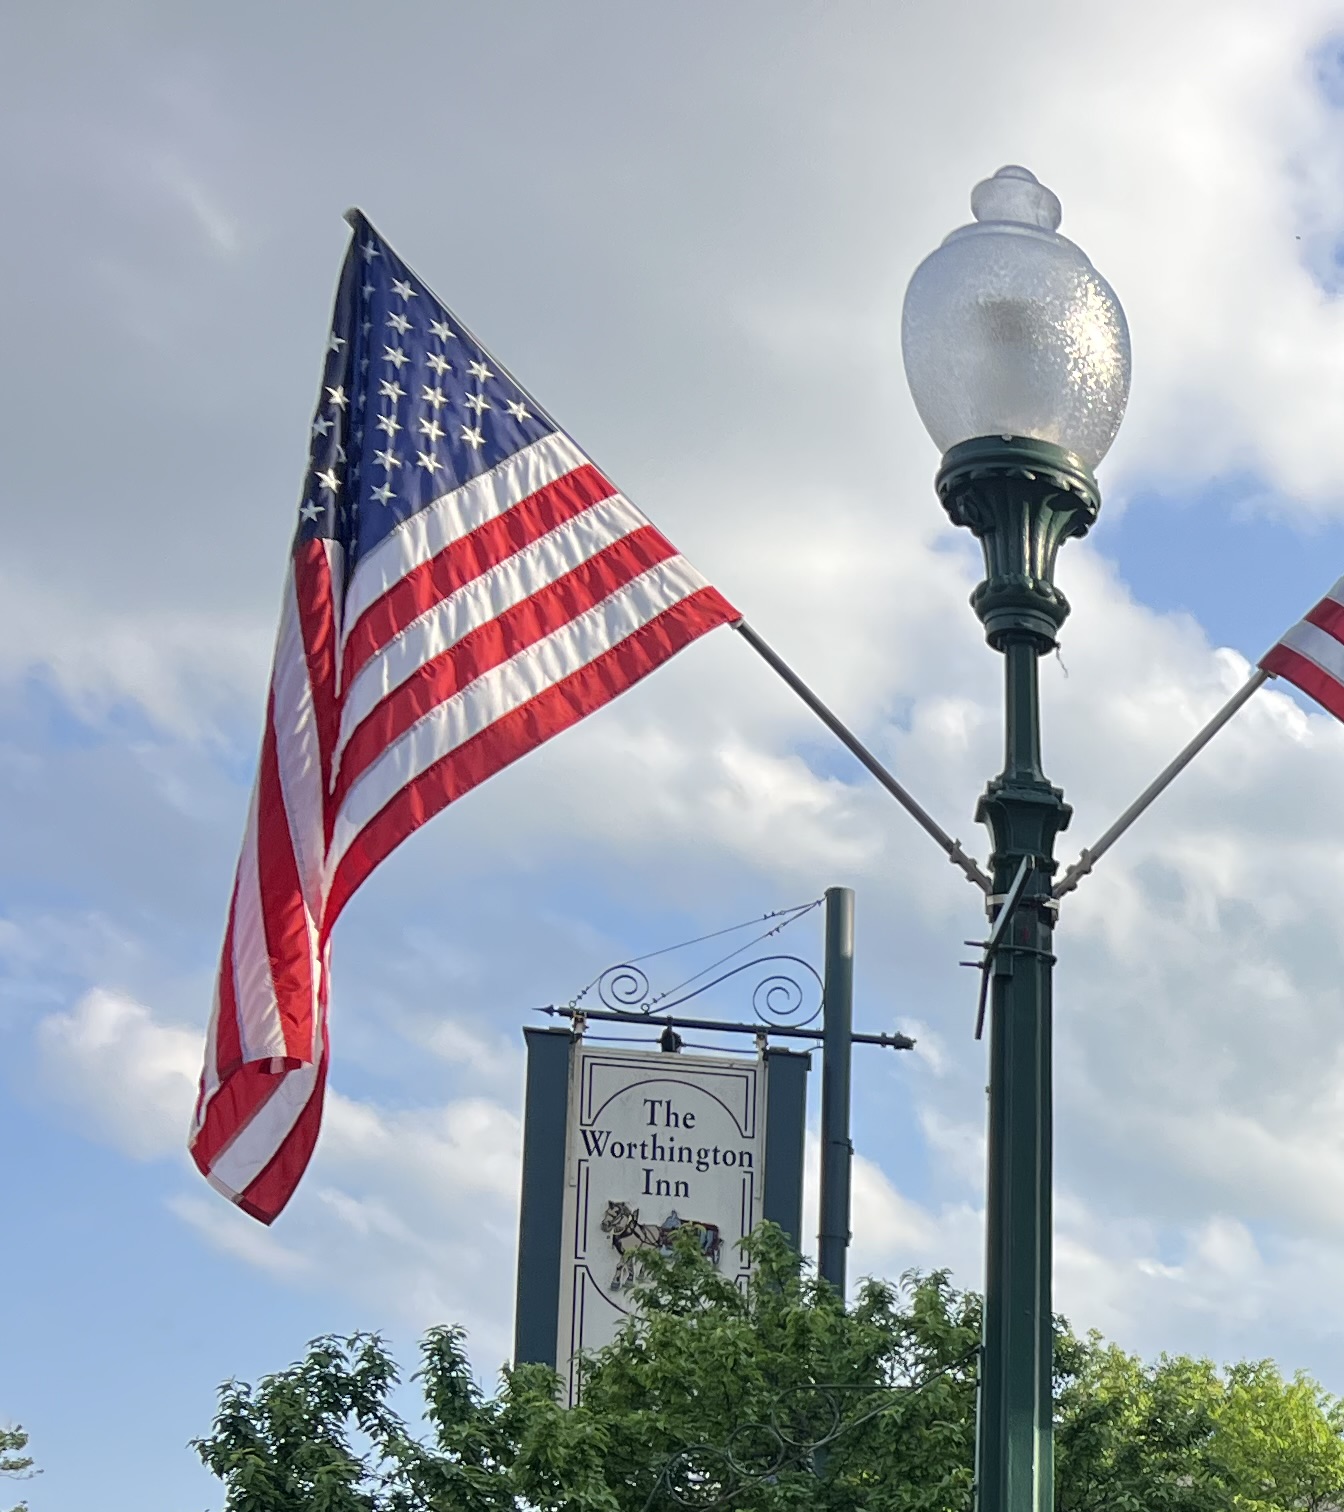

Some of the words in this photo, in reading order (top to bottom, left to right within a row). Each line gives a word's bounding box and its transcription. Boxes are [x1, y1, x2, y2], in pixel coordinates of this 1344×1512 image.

[643, 1098, 696, 1129] The
[579, 1129, 753, 1172] Worthington
[641, 1168, 690, 1198] Inn
